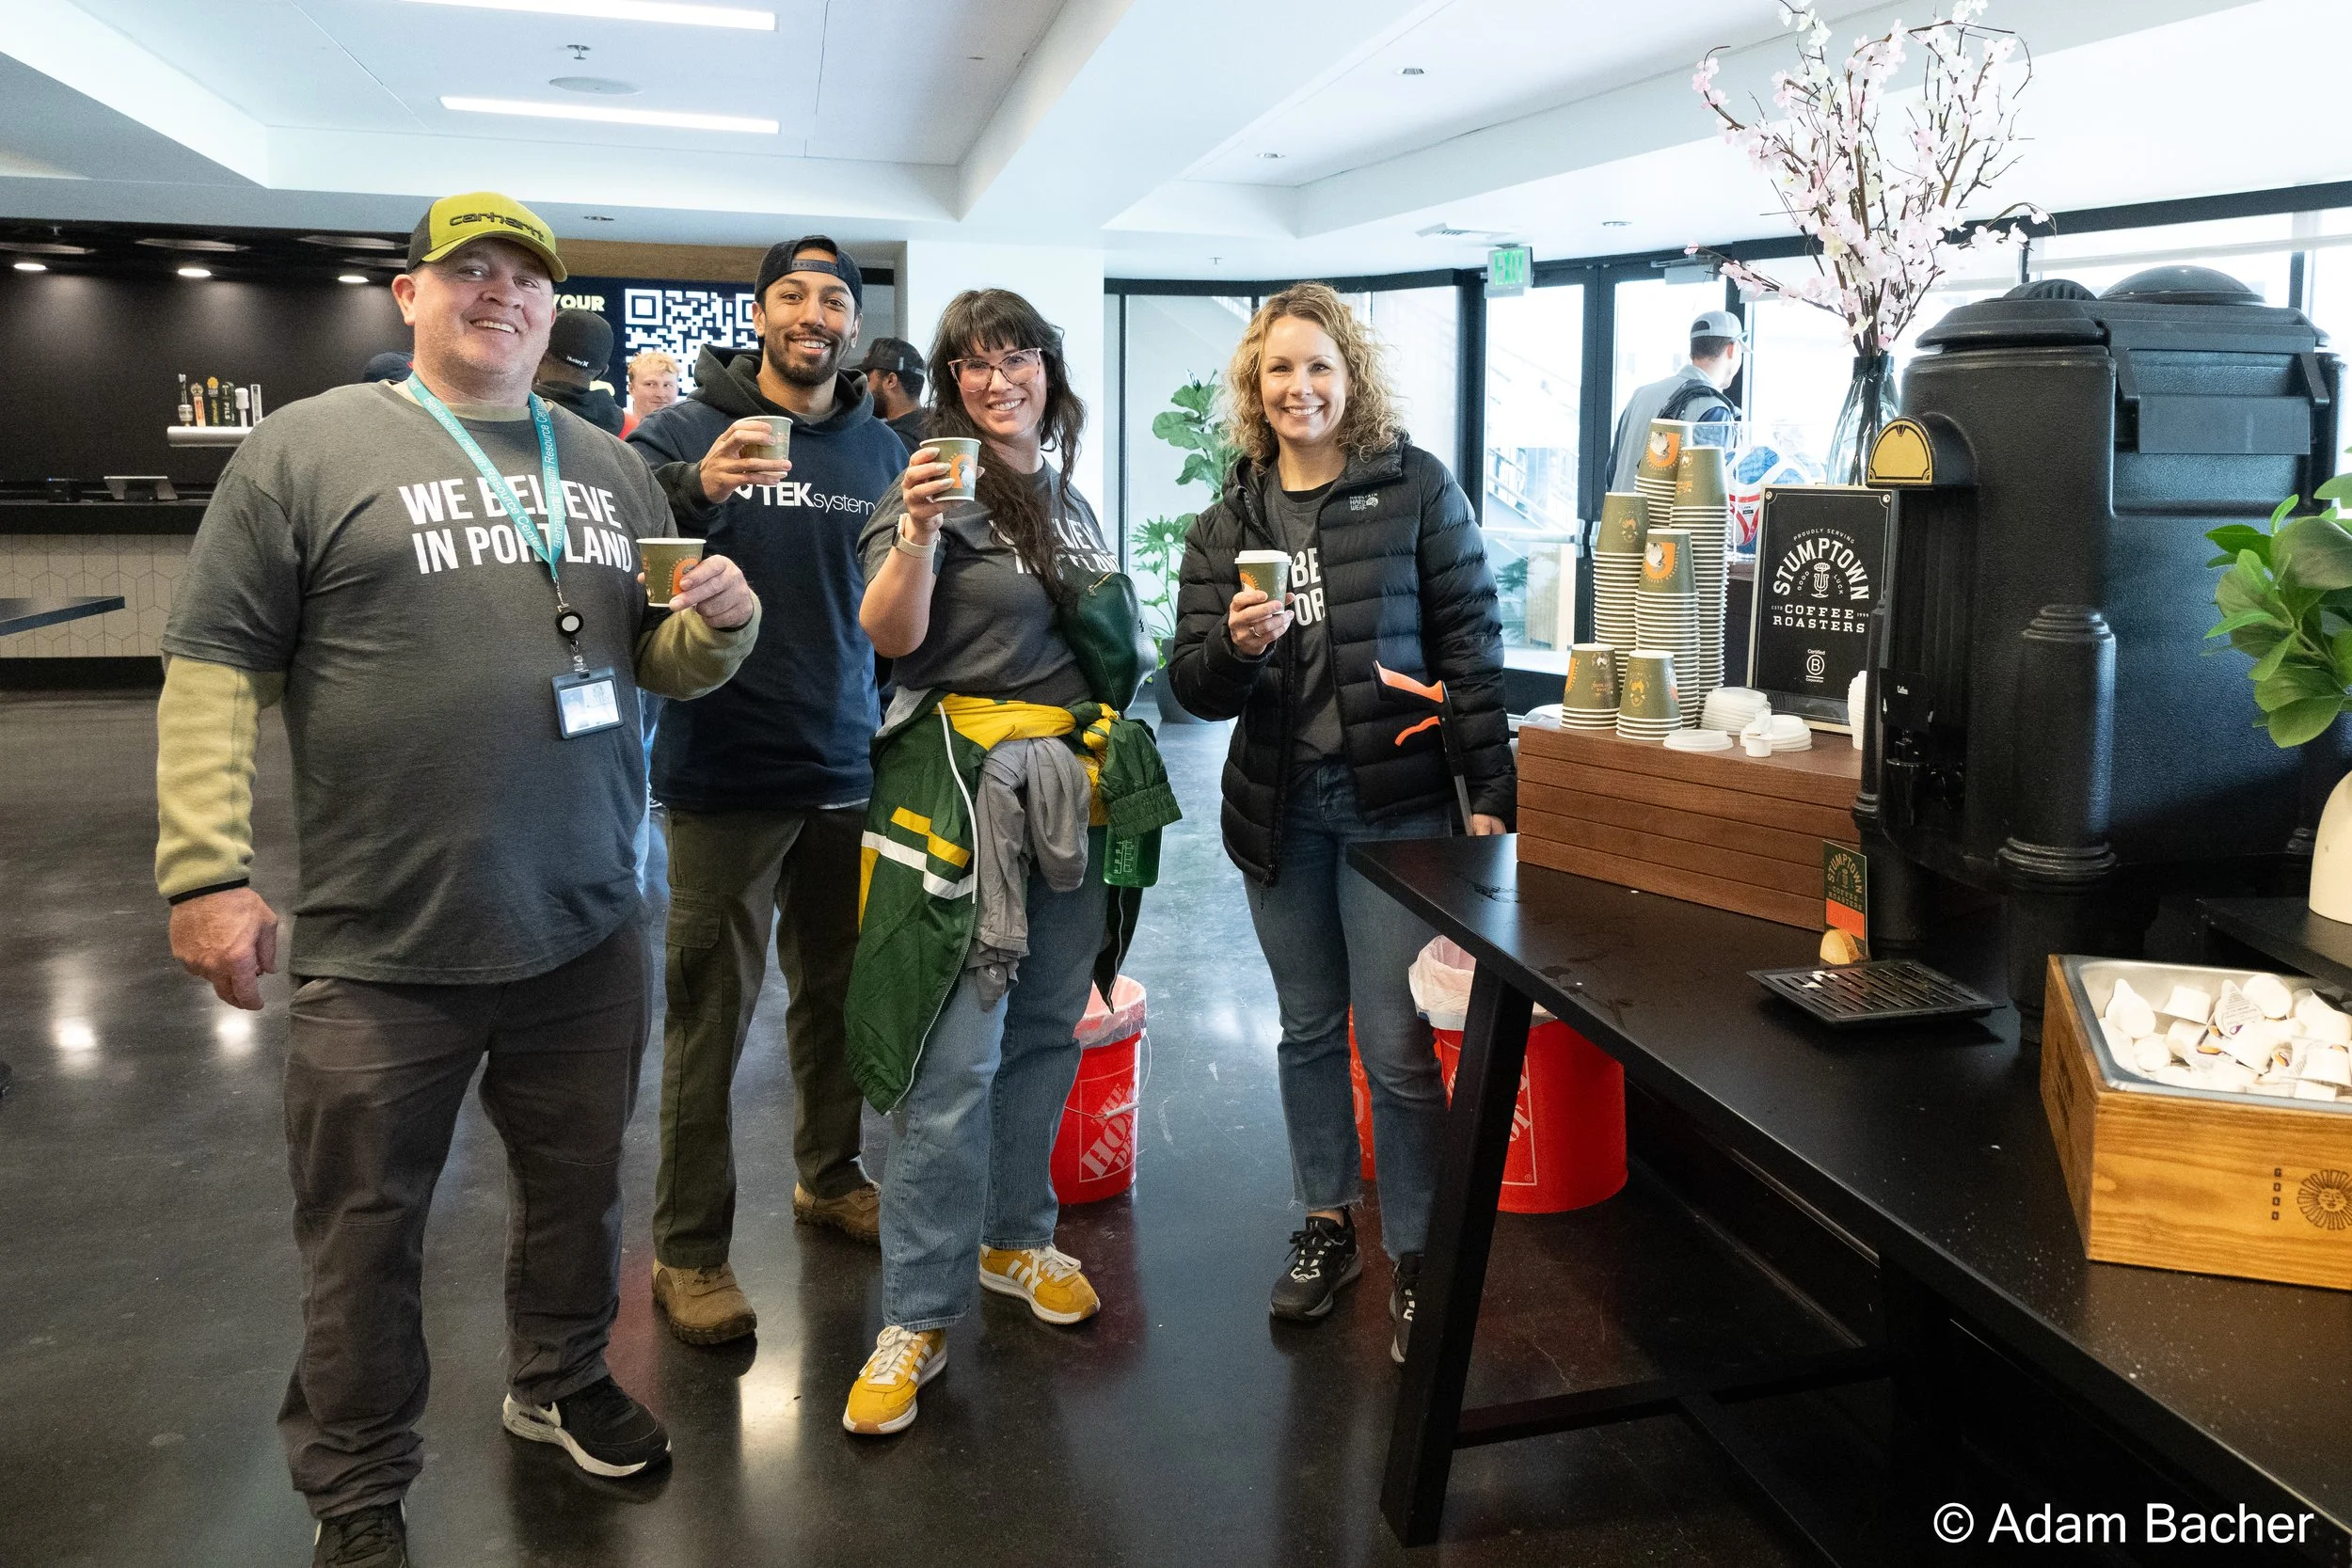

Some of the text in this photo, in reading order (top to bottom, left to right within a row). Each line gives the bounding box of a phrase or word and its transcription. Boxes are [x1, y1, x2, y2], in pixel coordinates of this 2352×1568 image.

[450, 212, 544, 244] carhartt
[1493, 249, 1524, 286] EXIT
[422, 396, 545, 551] Behavioral Health Resource Center
[535, 398, 564, 549] Behavioral Health Resource Center
[398, 474, 623, 530] WE BELEVE
[412, 529, 459, 574] IN
[1793, 528, 1855, 545] PROUDLY SERVING
[1772, 537, 1870, 601] STUMPTOWN
[1834, 574, 1844, 595] LUCK
[1772, 615, 1866, 633] ROASTERS
[1785, 604, 1854, 620] COFFEE
[1827, 853, 1863, 894] STUMPTOWN
[1828, 891, 1863, 911] ROASTERS
[1832, 885, 1858, 902] COFFEE
